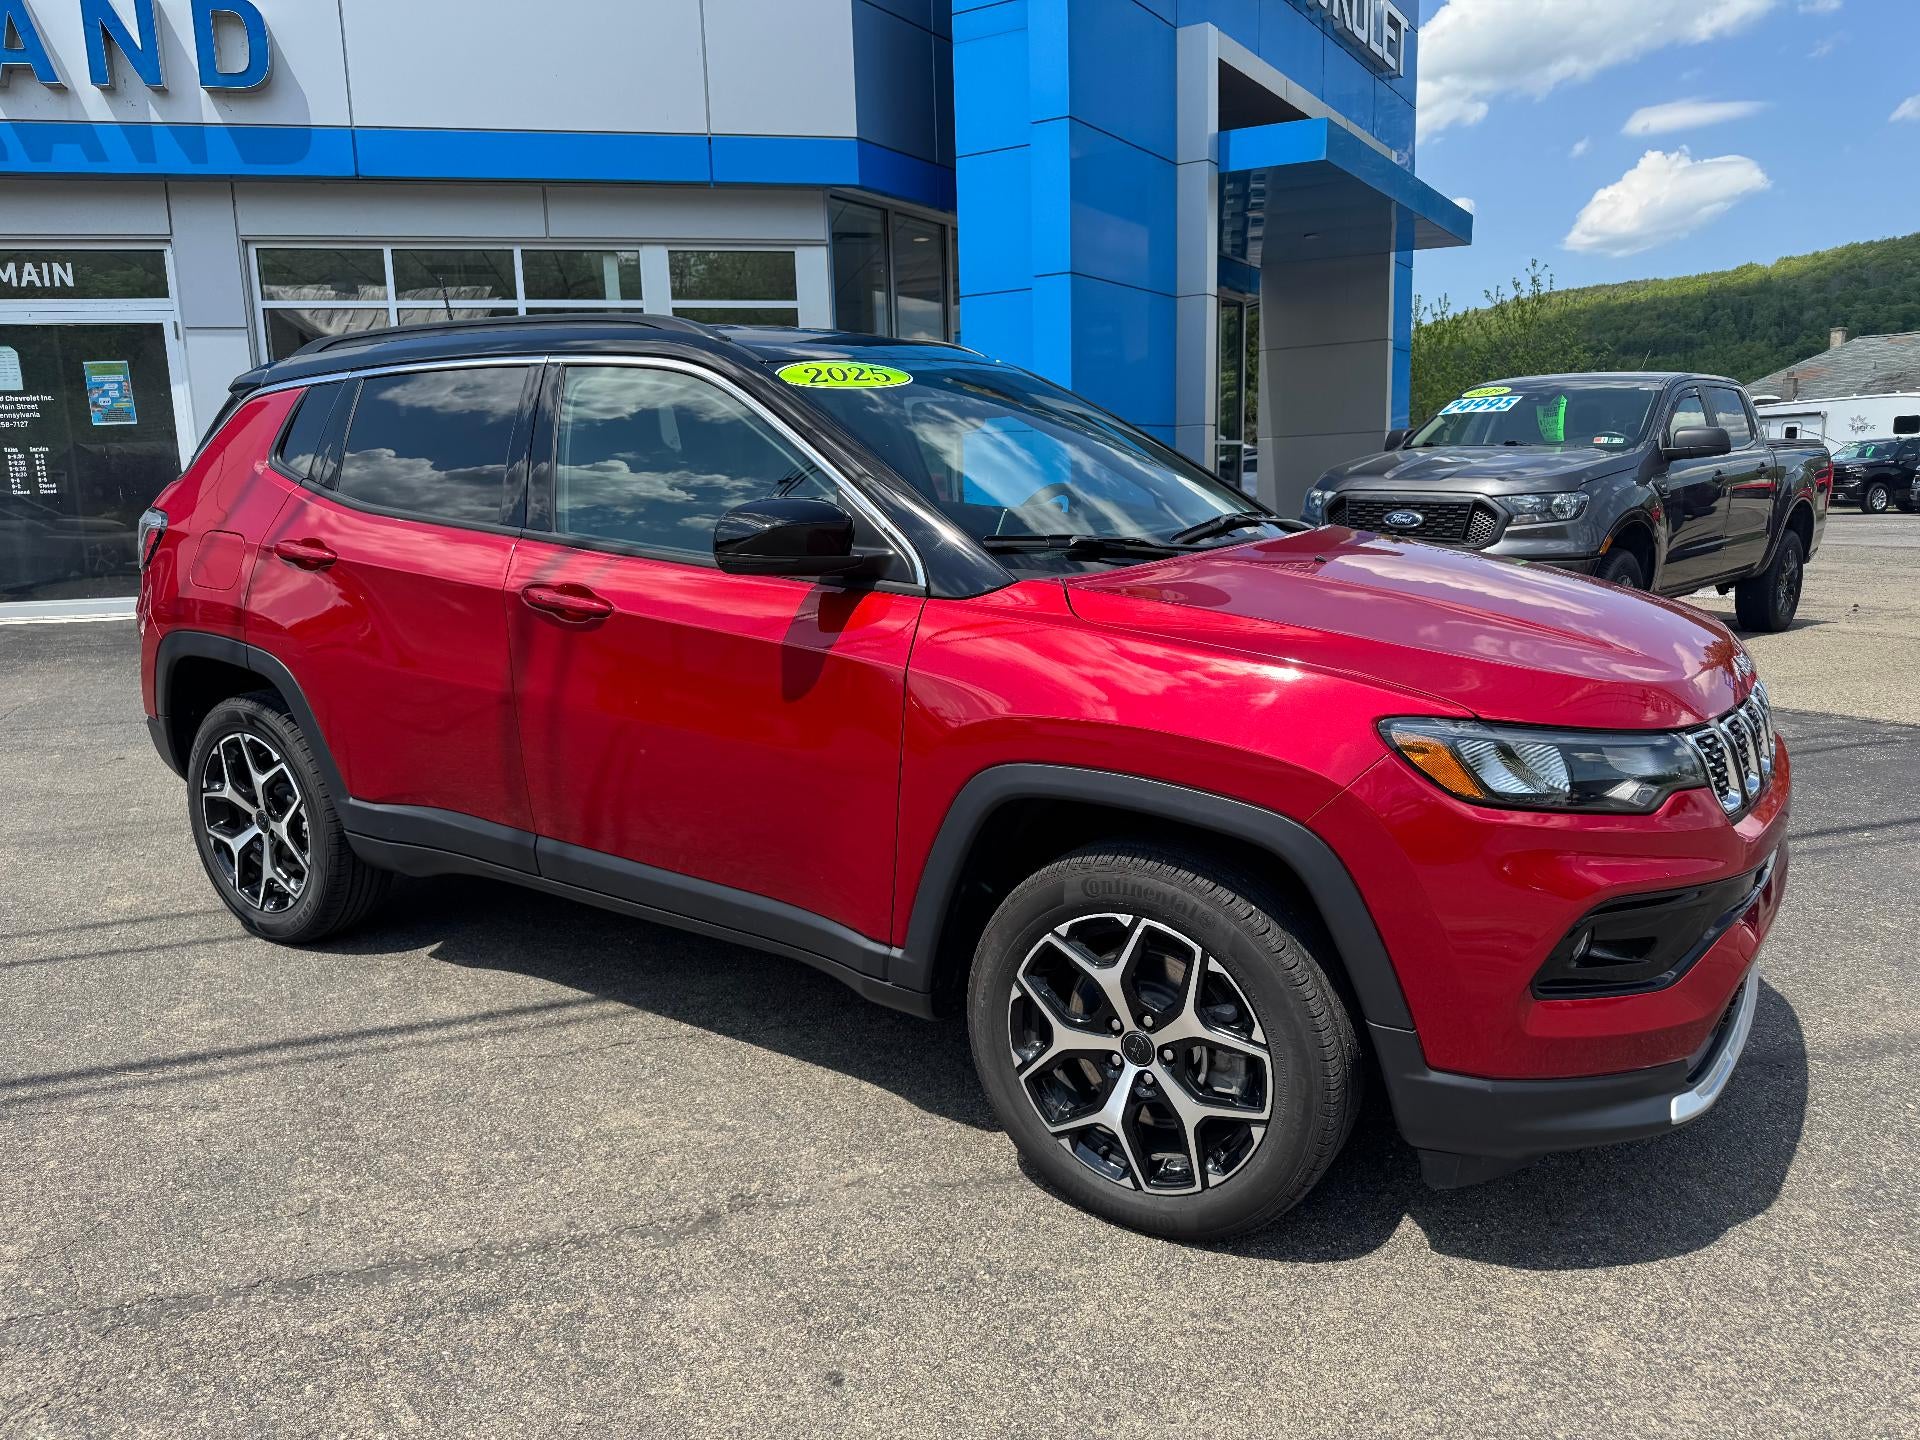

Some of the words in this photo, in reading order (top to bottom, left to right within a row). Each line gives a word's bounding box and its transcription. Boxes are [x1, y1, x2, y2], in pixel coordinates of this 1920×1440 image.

[1318, 0, 1409, 78] OLET
[0, 262, 75, 287] MAIN
[803, 366, 892, 384] 2025
[1390, 512, 1413, 524] Ford
